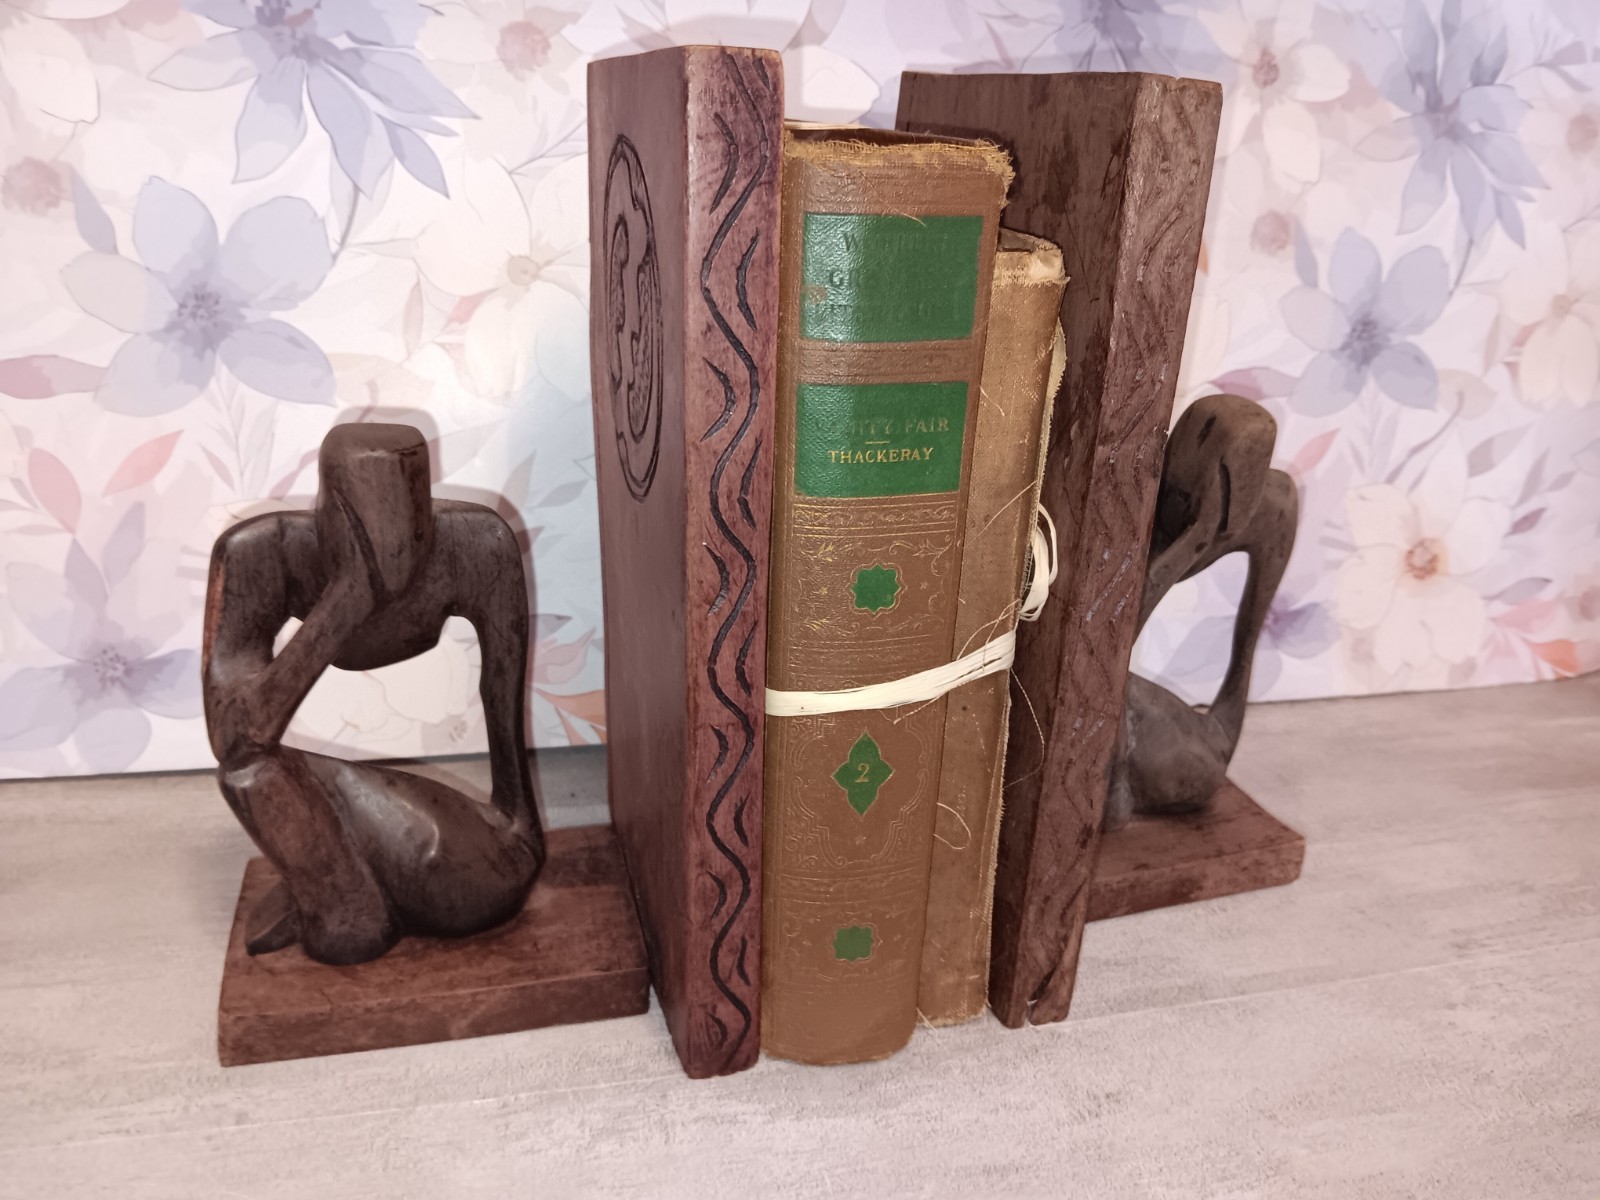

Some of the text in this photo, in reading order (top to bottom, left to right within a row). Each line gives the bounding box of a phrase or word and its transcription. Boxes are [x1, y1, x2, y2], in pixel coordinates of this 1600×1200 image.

[904, 415, 950, 434] FAIR
[827, 446, 934, 465] THACKERAY
[855, 762, 870, 783] 2
